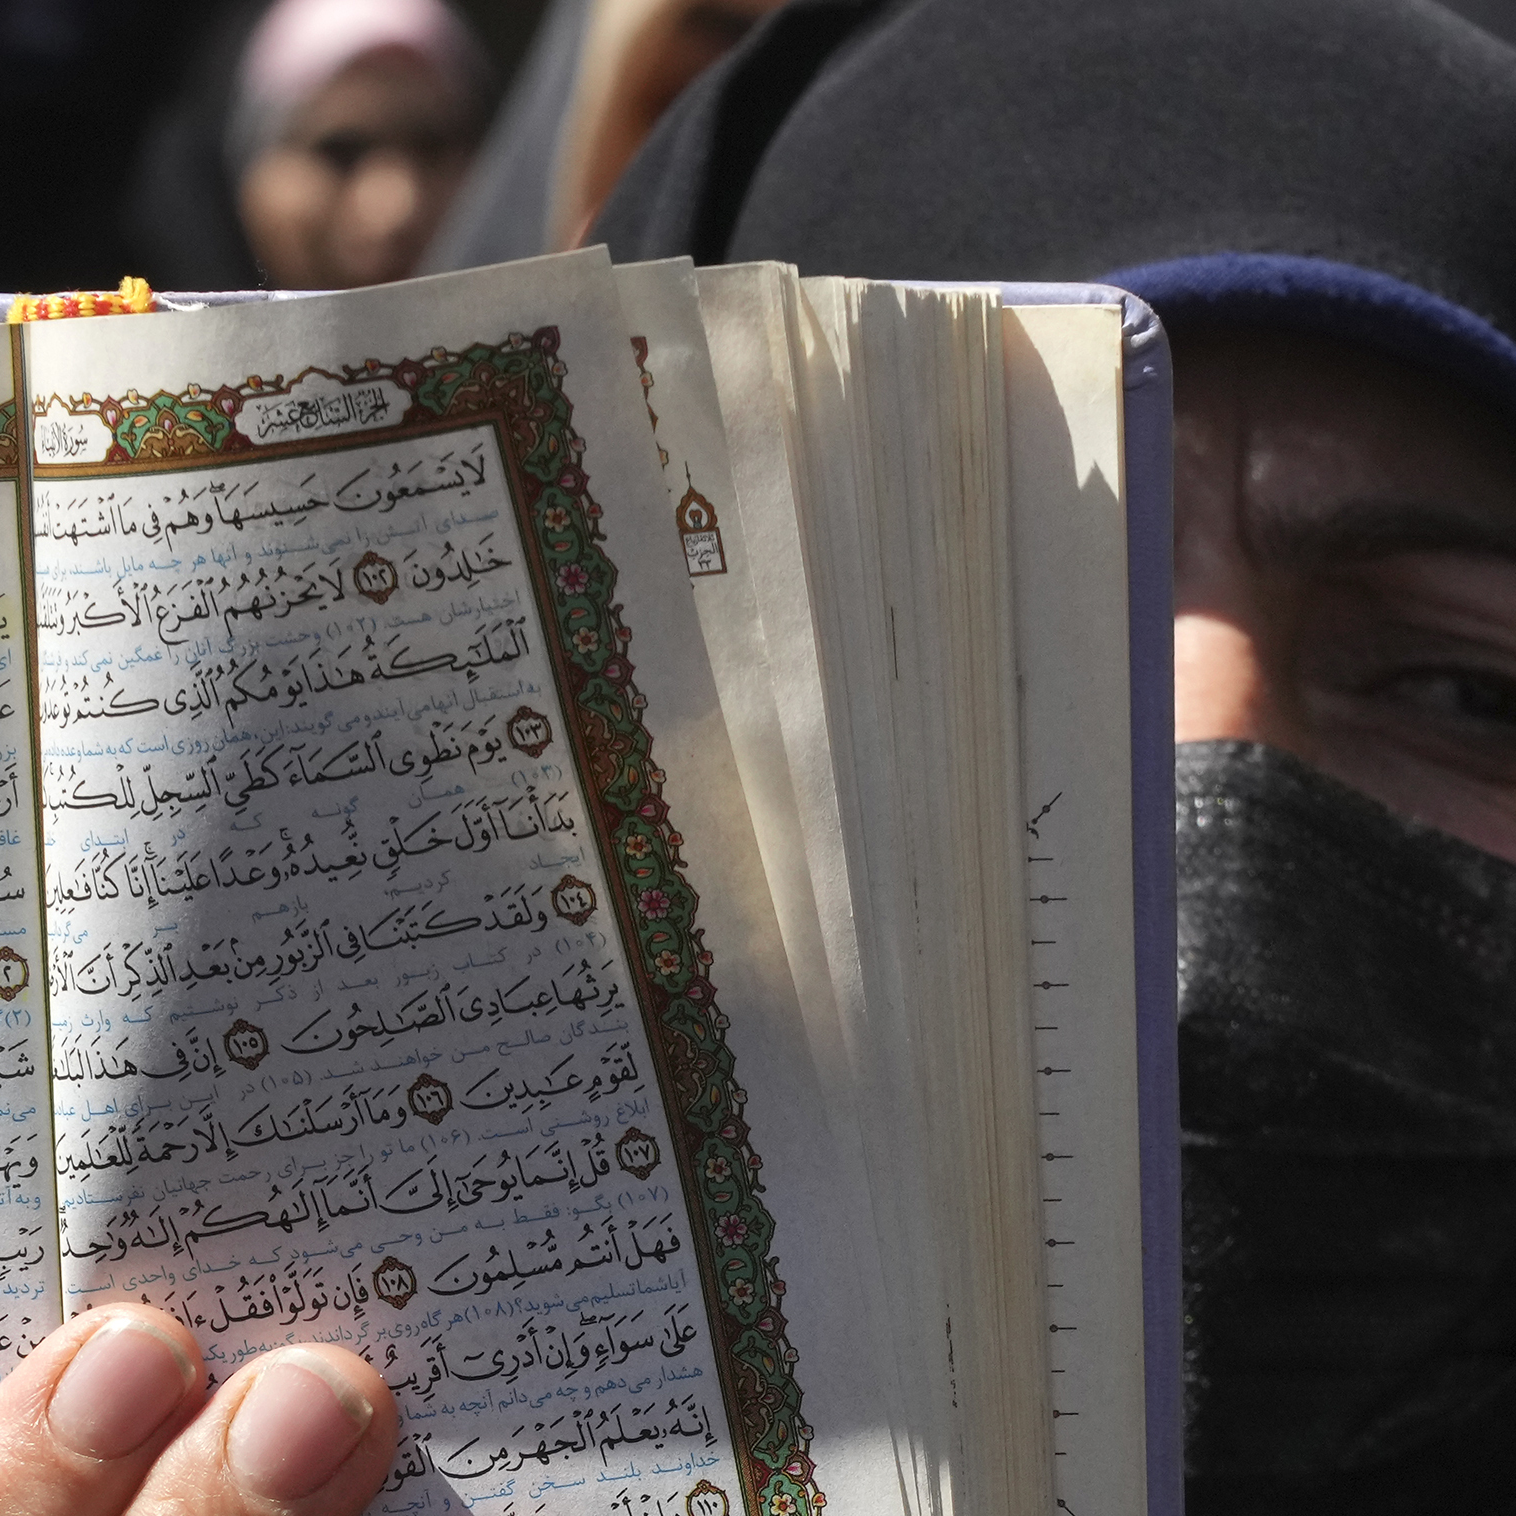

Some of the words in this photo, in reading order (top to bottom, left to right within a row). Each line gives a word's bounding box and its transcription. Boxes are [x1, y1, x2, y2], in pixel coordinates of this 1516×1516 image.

[596, 1463, 641, 1484] بلند
[652, 1452, 721, 1476] خداوند
[462, 1479, 515, 1509] گفتن
[528, 1474, 586, 1499] سخن
